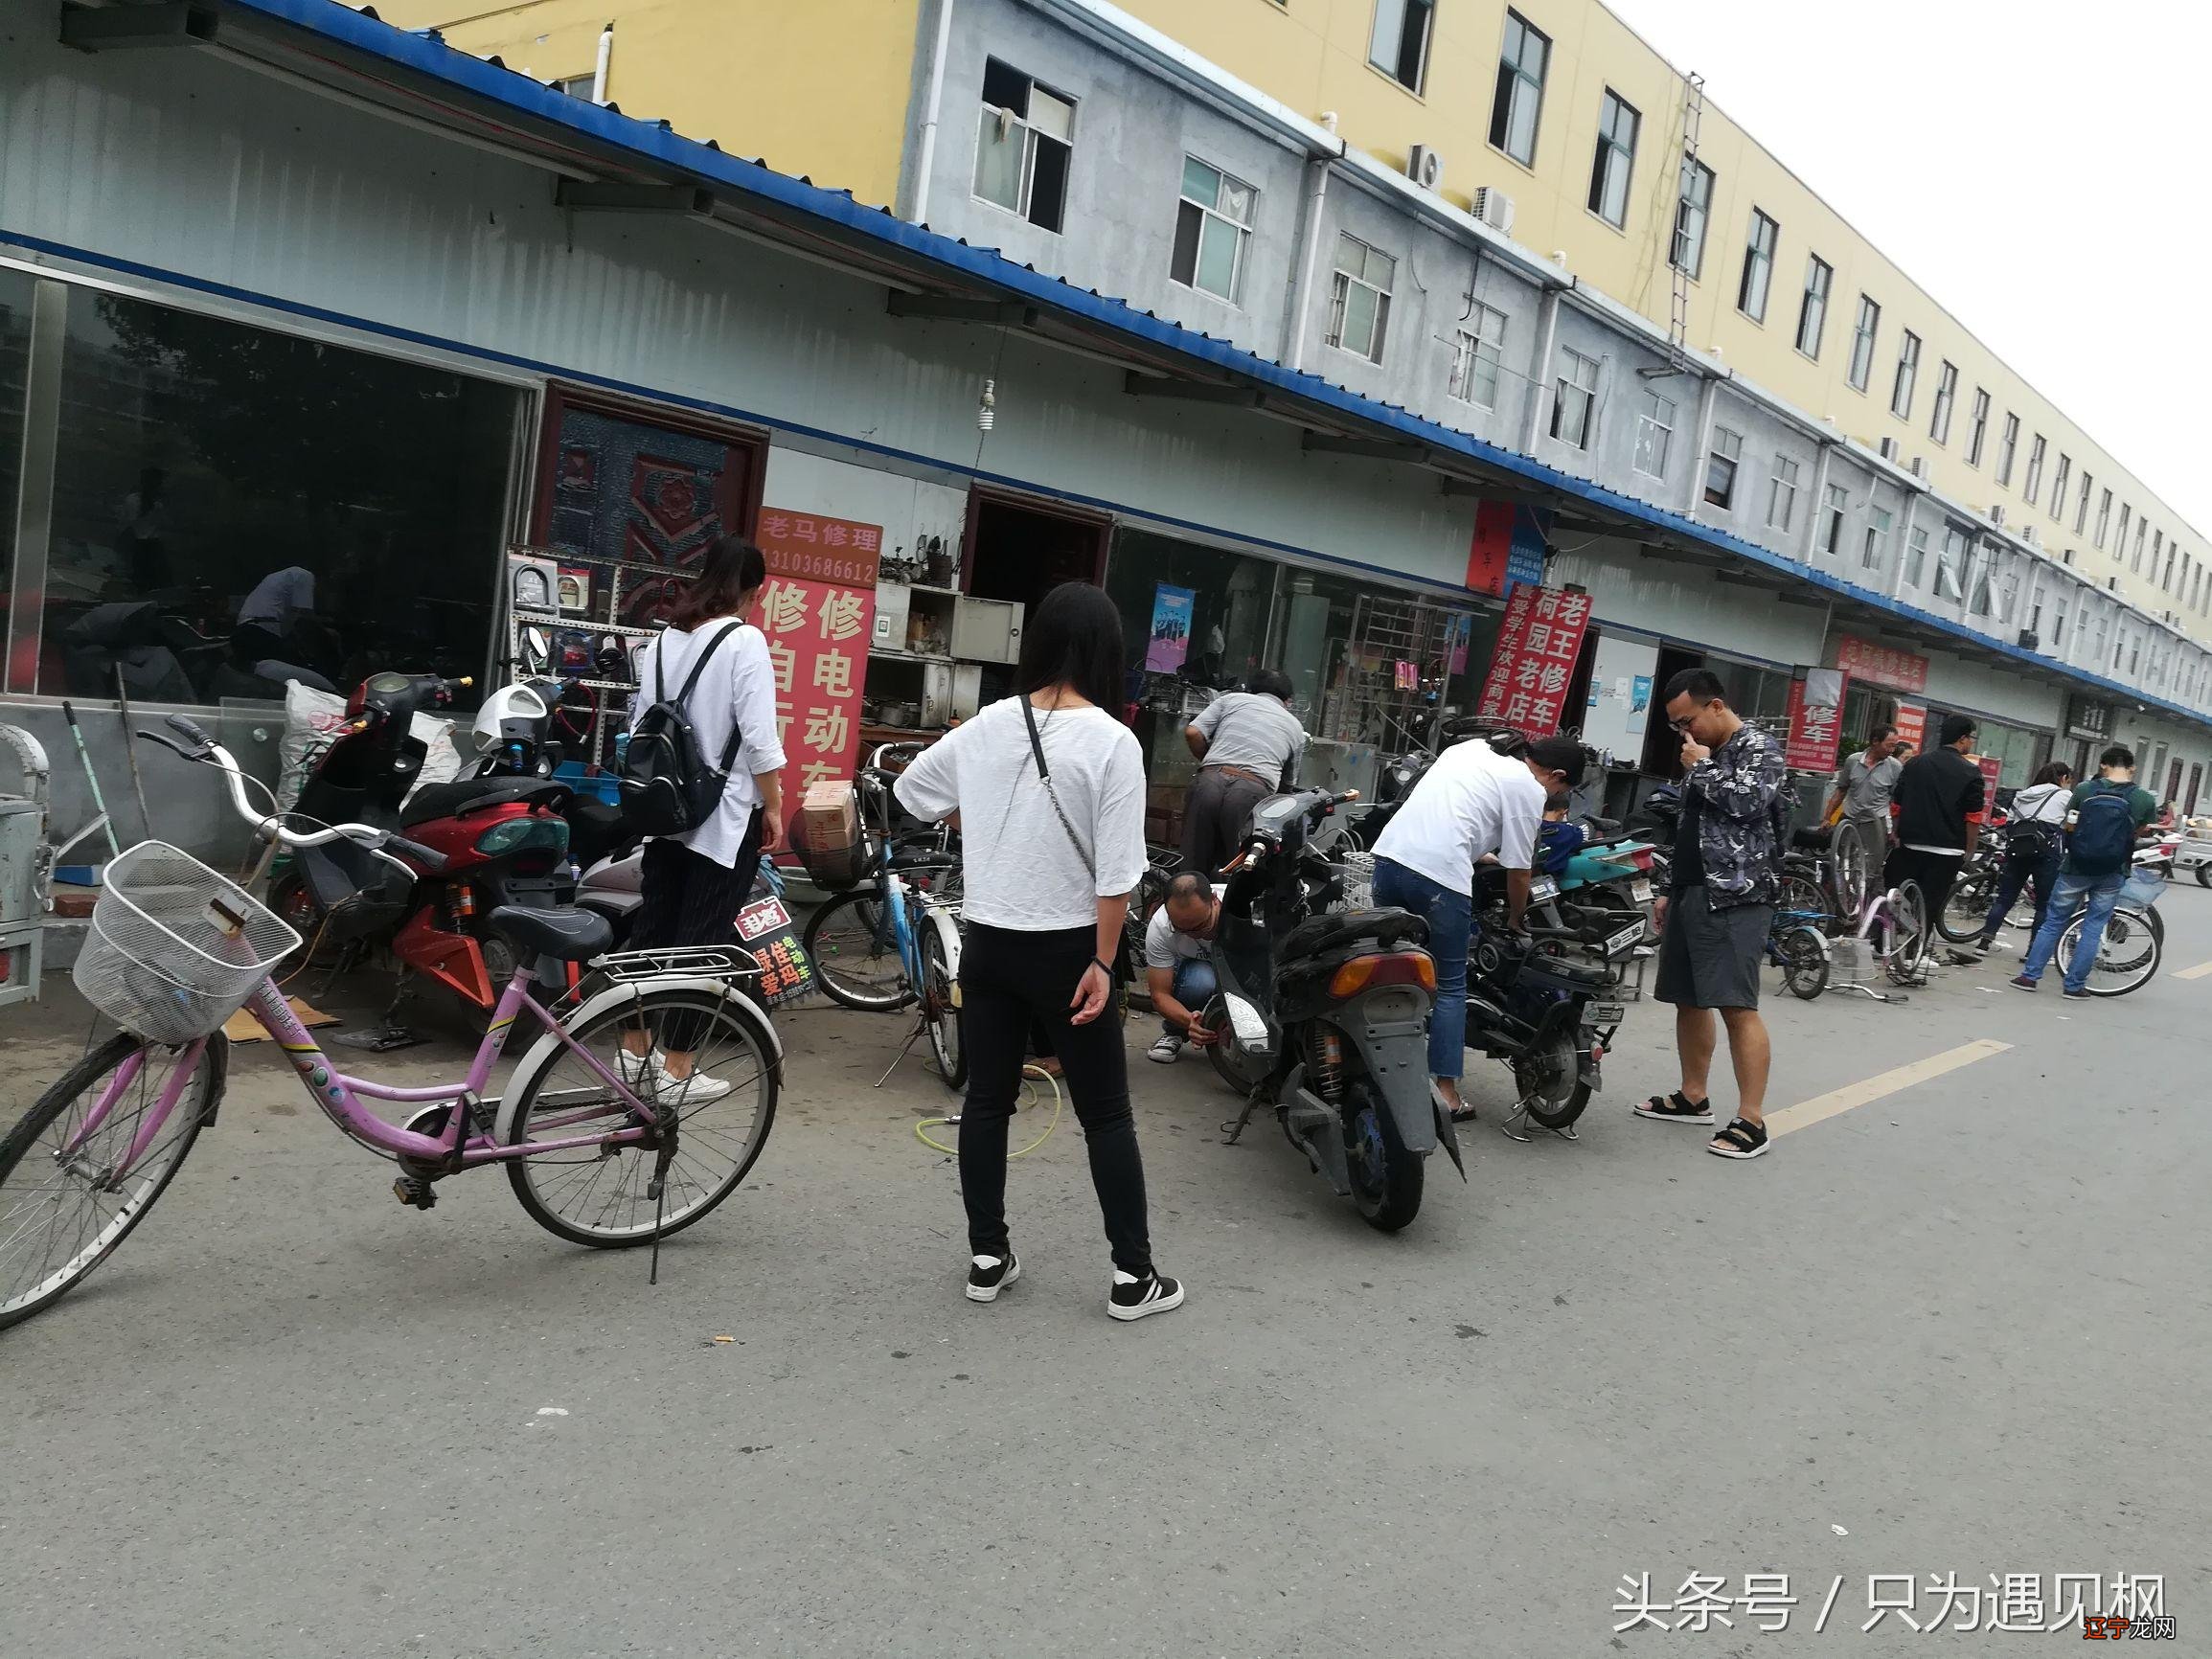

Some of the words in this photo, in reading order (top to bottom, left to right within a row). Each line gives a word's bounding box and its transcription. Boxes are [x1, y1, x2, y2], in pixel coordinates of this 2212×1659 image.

[764, 515, 878, 552] 老马修理
[760, 580, 809, 798] 修自
[796, 588, 865, 799] 修电动车
[1504, 585, 1564, 723] 荷园老店
[1528, 593, 1588, 728] 老王修车
[1801, 705, 1837, 743] 修车
